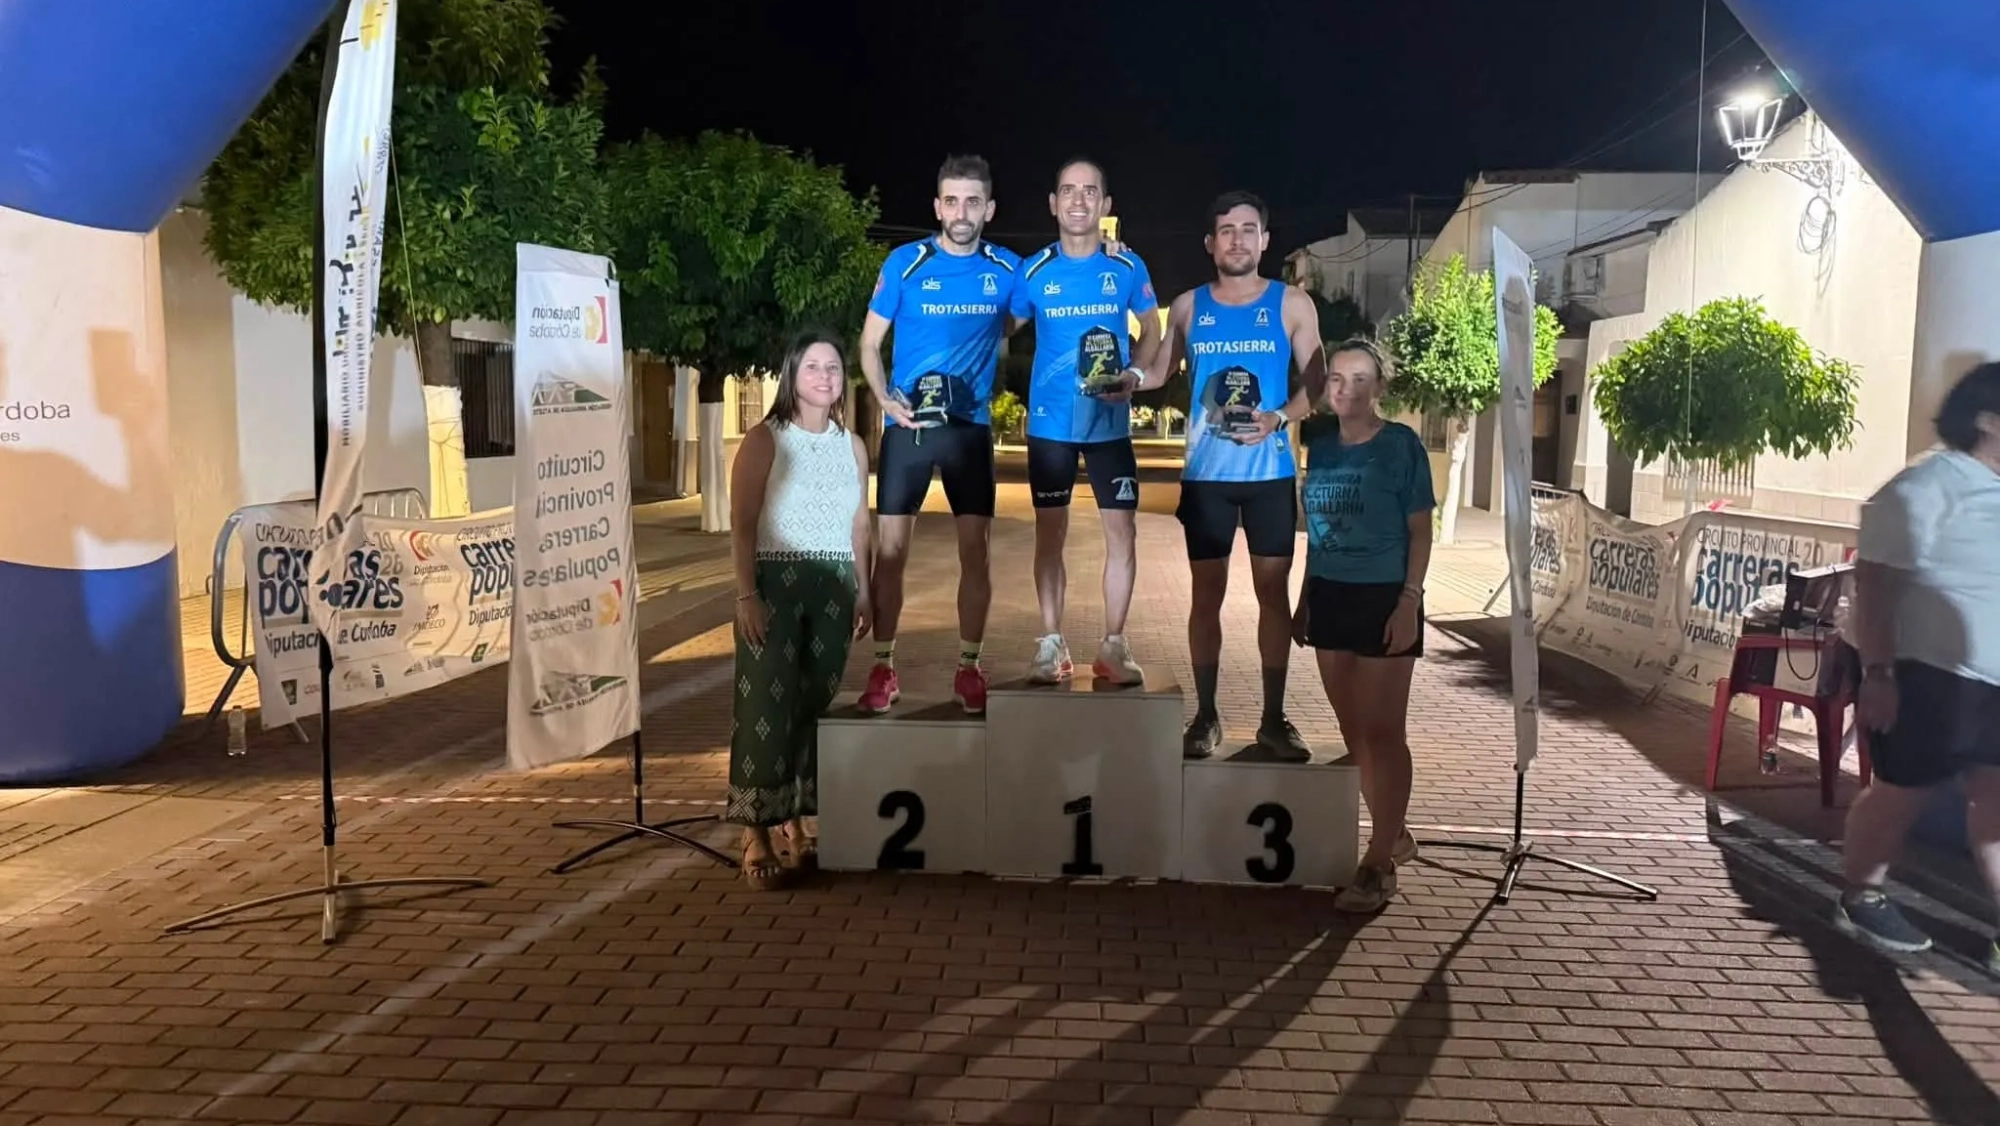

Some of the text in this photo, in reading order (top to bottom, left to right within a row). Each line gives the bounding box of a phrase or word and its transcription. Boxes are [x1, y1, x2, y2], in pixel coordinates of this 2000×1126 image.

[921, 303, 998, 315] TROTASIERRA
[1044, 303, 1119, 318] TROTASIERRA
[1191, 340, 1276, 355] TROTASIERRA
[1589, 537, 1657, 571] carreras
[1697, 527, 1739, 550] CIRCUITO
[1741, 531, 1800, 558] PROVINCIAL
[1590, 563, 1661, 600] populares
[1622, 603, 1634, 622] de
[876, 790, 926, 870] 2
[1062, 795, 1103, 876] 1
[1246, 802, 1297, 883] 3
